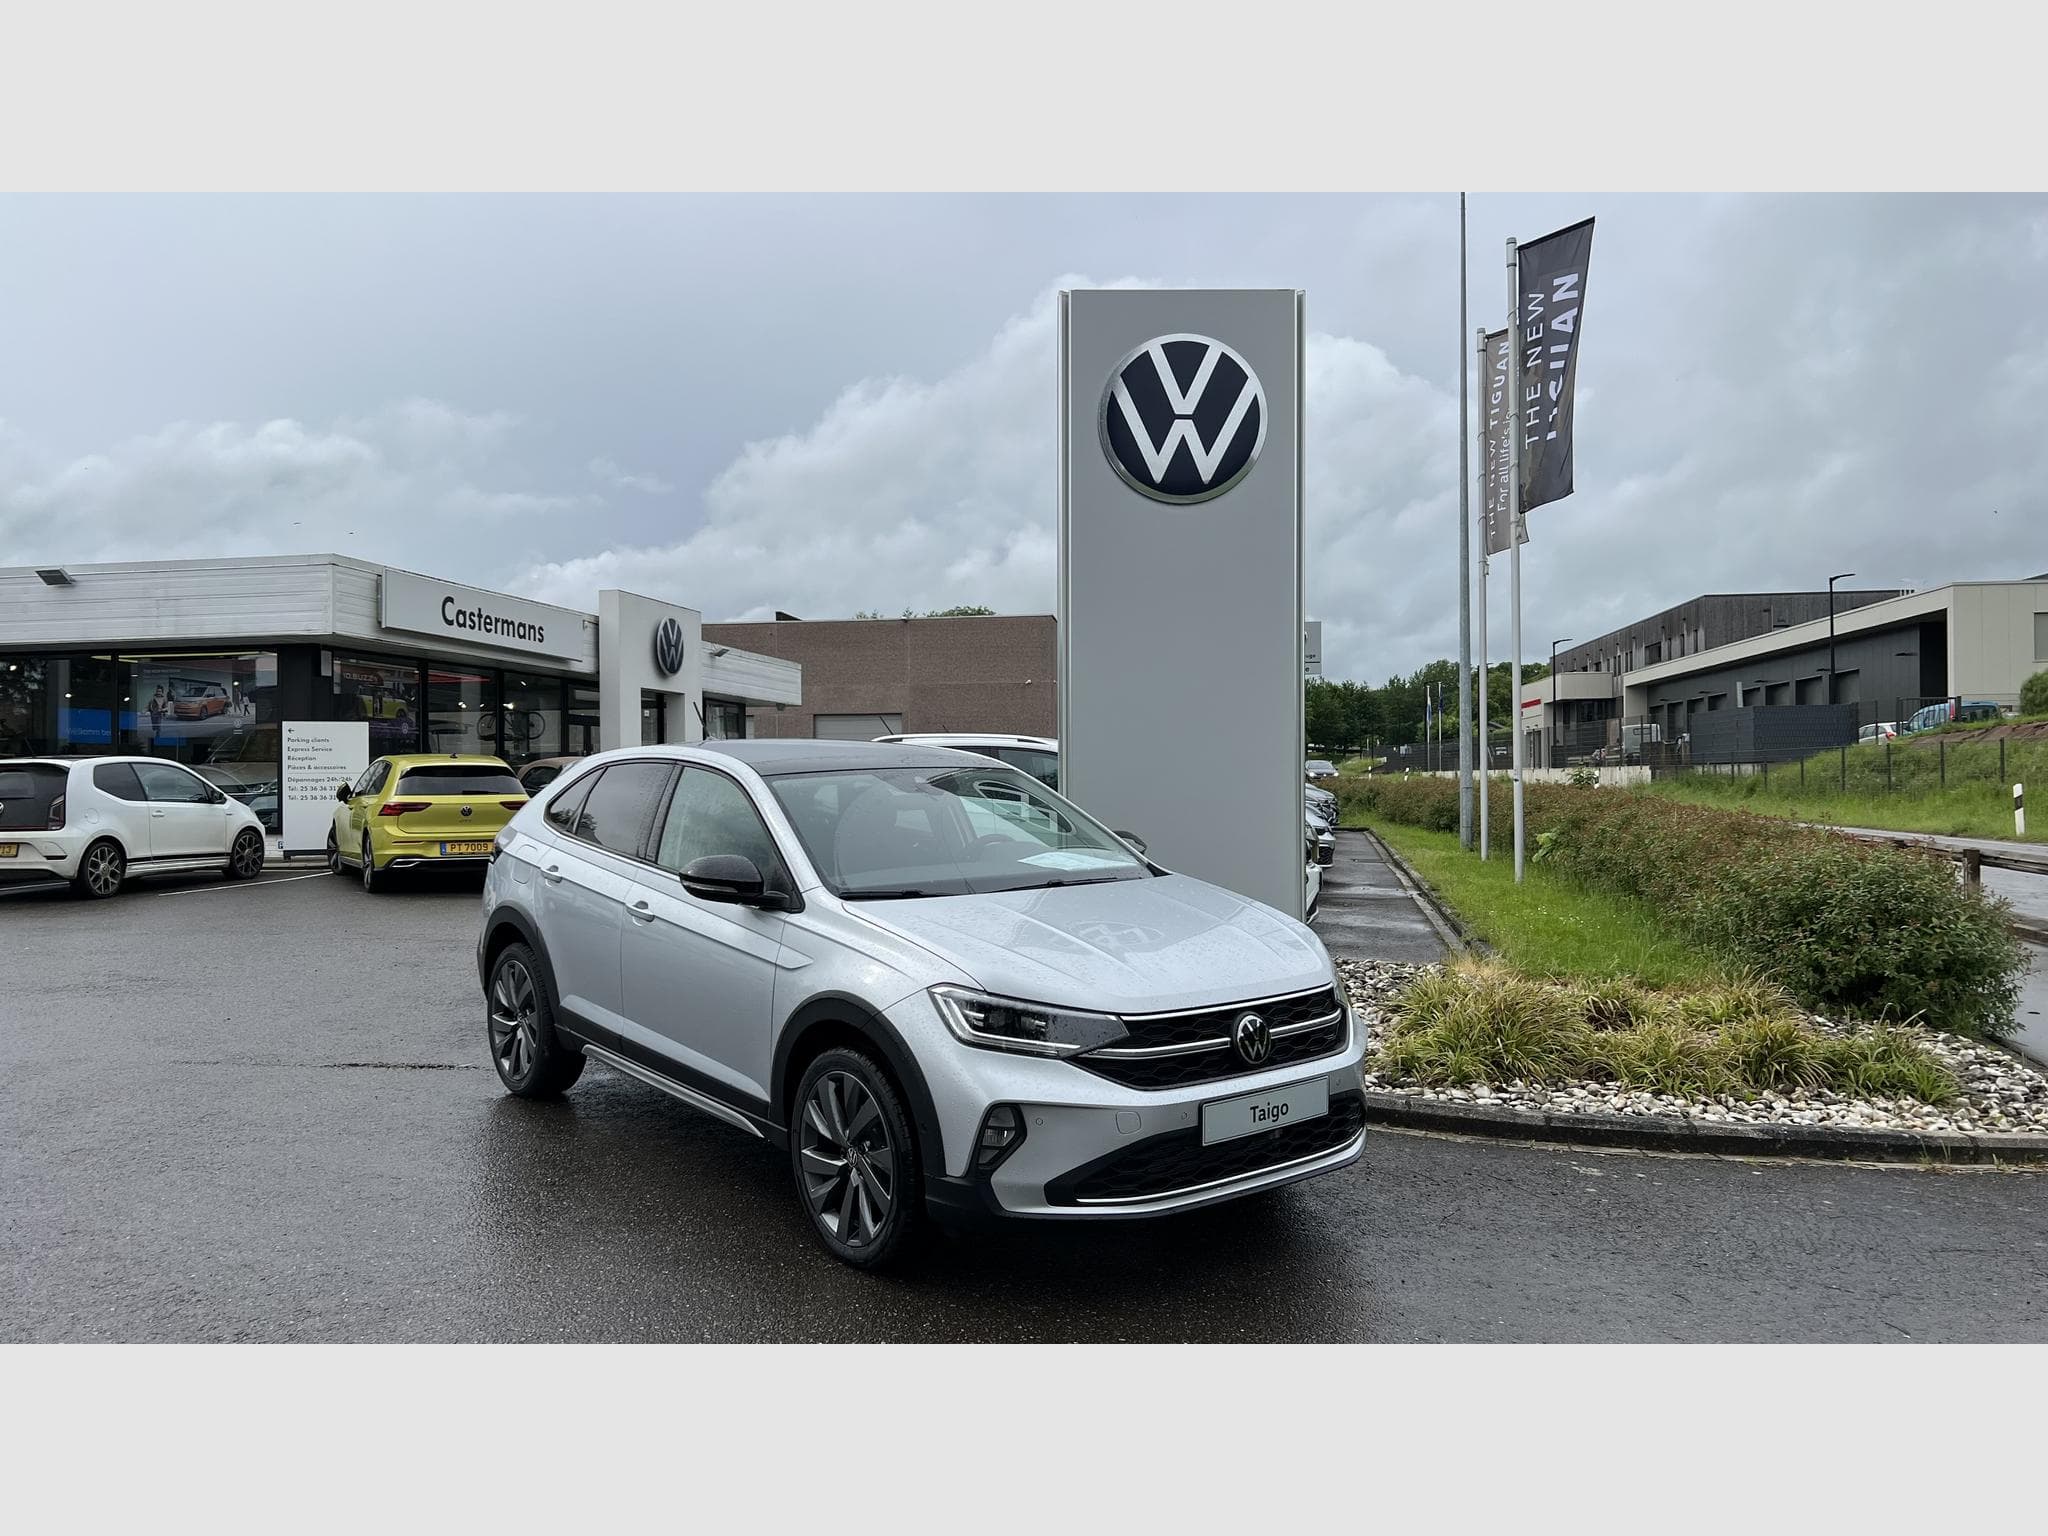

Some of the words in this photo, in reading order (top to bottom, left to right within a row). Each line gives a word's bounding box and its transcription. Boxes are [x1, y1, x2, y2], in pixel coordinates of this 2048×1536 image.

[1526, 293, 1545, 368] NEW
[1489, 341, 1510, 431] TIGUAN
[1525, 383, 1542, 450] THE
[1498, 465, 1510, 484] all
[441, 596, 545, 644] Castermans
[450, 843, 463, 852] PT
[464, 842, 489, 851] 7009
[1250, 1102, 1289, 1123] Taigo
